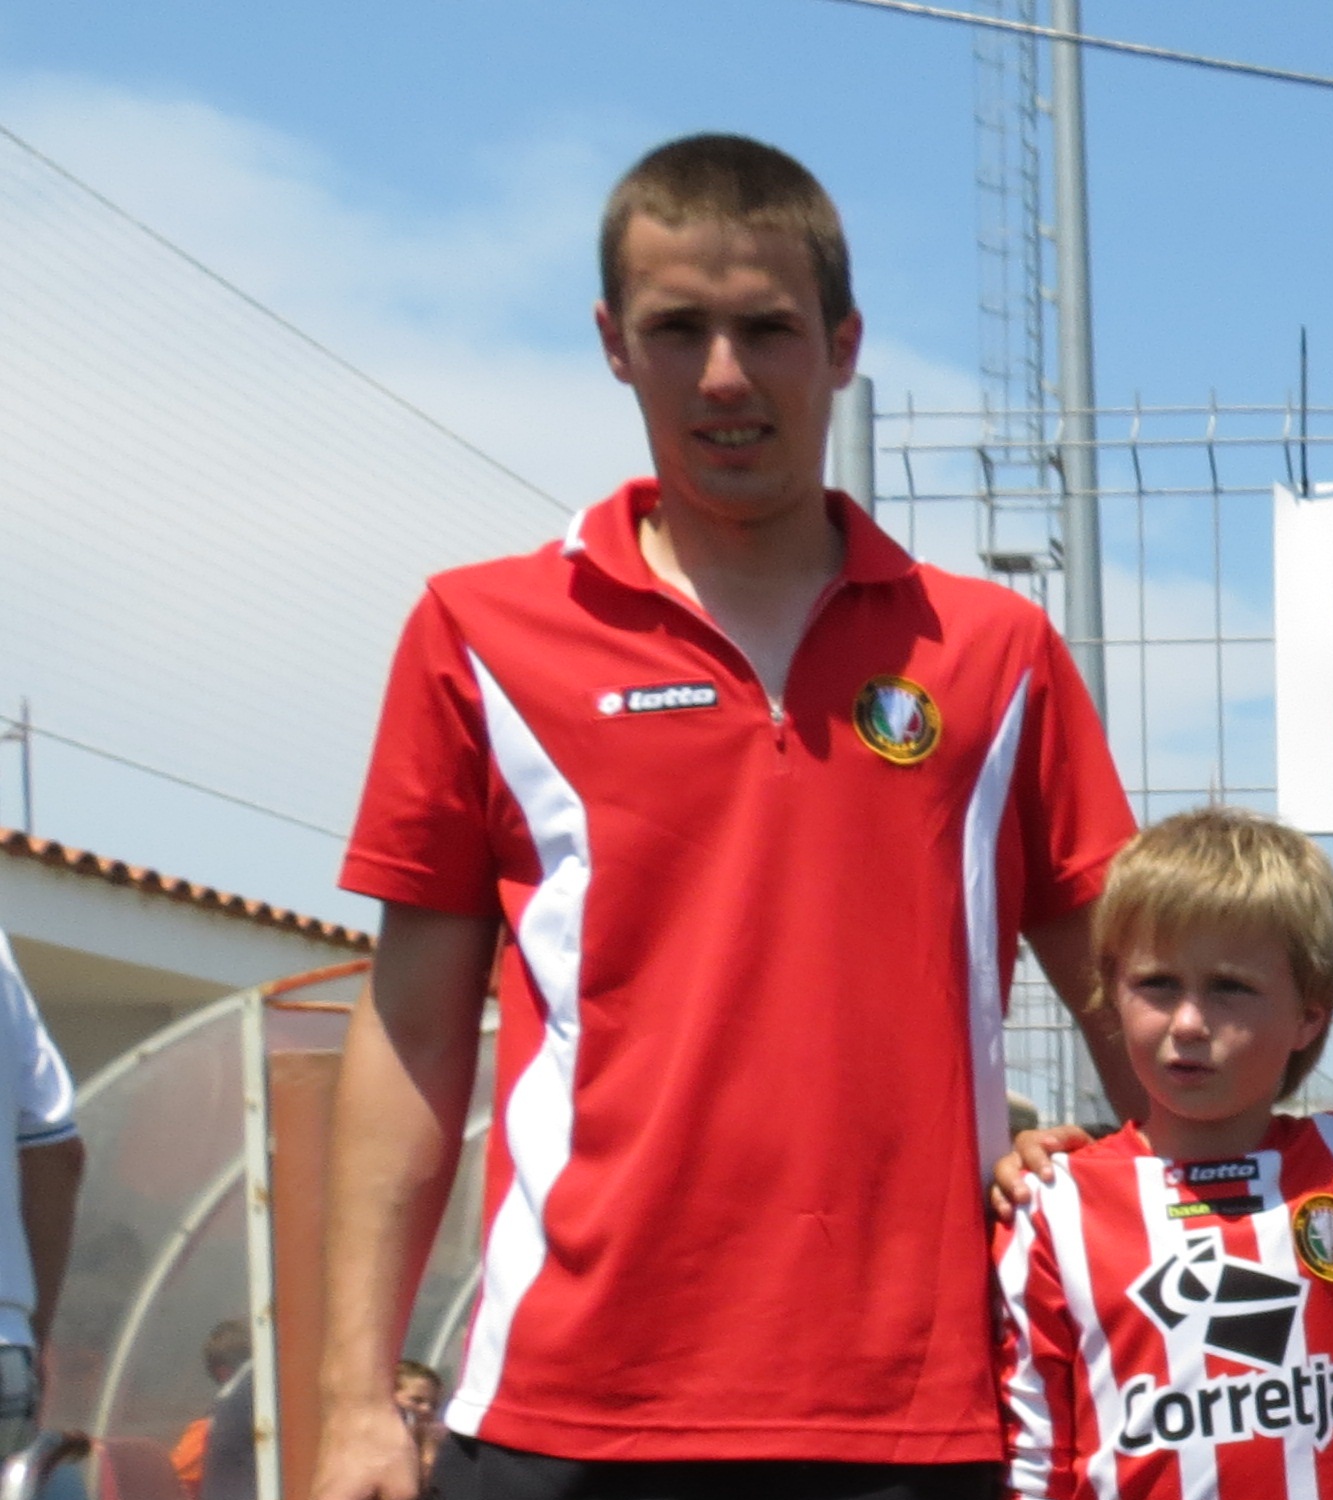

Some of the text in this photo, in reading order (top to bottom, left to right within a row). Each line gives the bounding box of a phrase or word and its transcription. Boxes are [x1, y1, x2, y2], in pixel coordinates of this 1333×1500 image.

[628, 686, 717, 711] lotto
[1189, 1163, 1256, 1182] lotto
[1168, 1202, 1212, 1218] base
